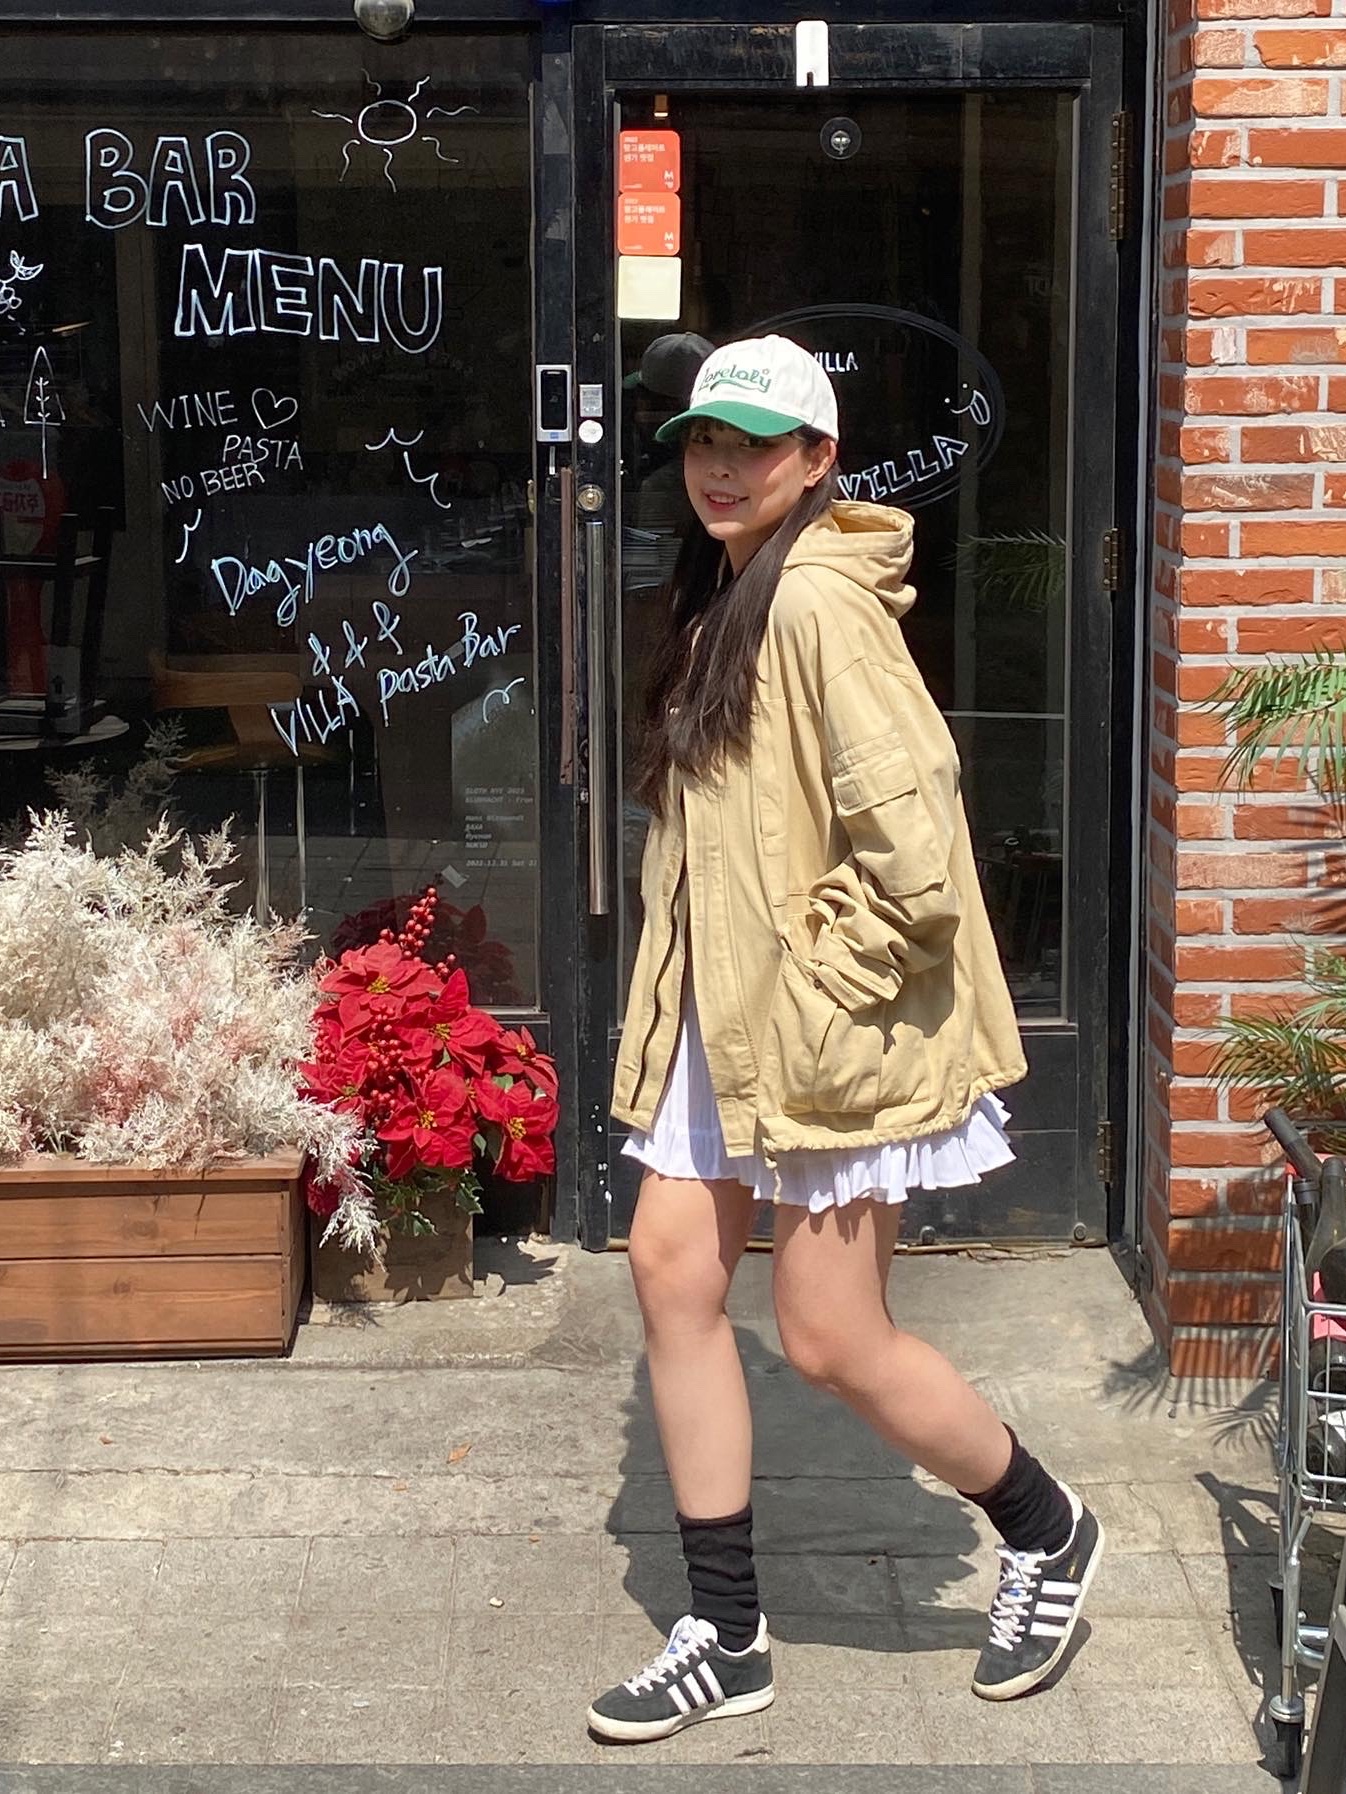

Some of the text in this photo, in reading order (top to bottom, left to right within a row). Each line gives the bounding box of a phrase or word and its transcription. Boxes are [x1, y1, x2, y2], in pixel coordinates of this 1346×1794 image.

[85, 128, 256, 230] BAR
[174, 243, 444, 354] MENU
[137, 389, 239, 433] WINE
[161, 460, 266, 506] NO BEER
[222, 434, 304, 471] PASTA
[837, 435, 970, 502] VILLA
[270, 675, 360, 757] VILLA
[456, 611, 522, 668] Bar
